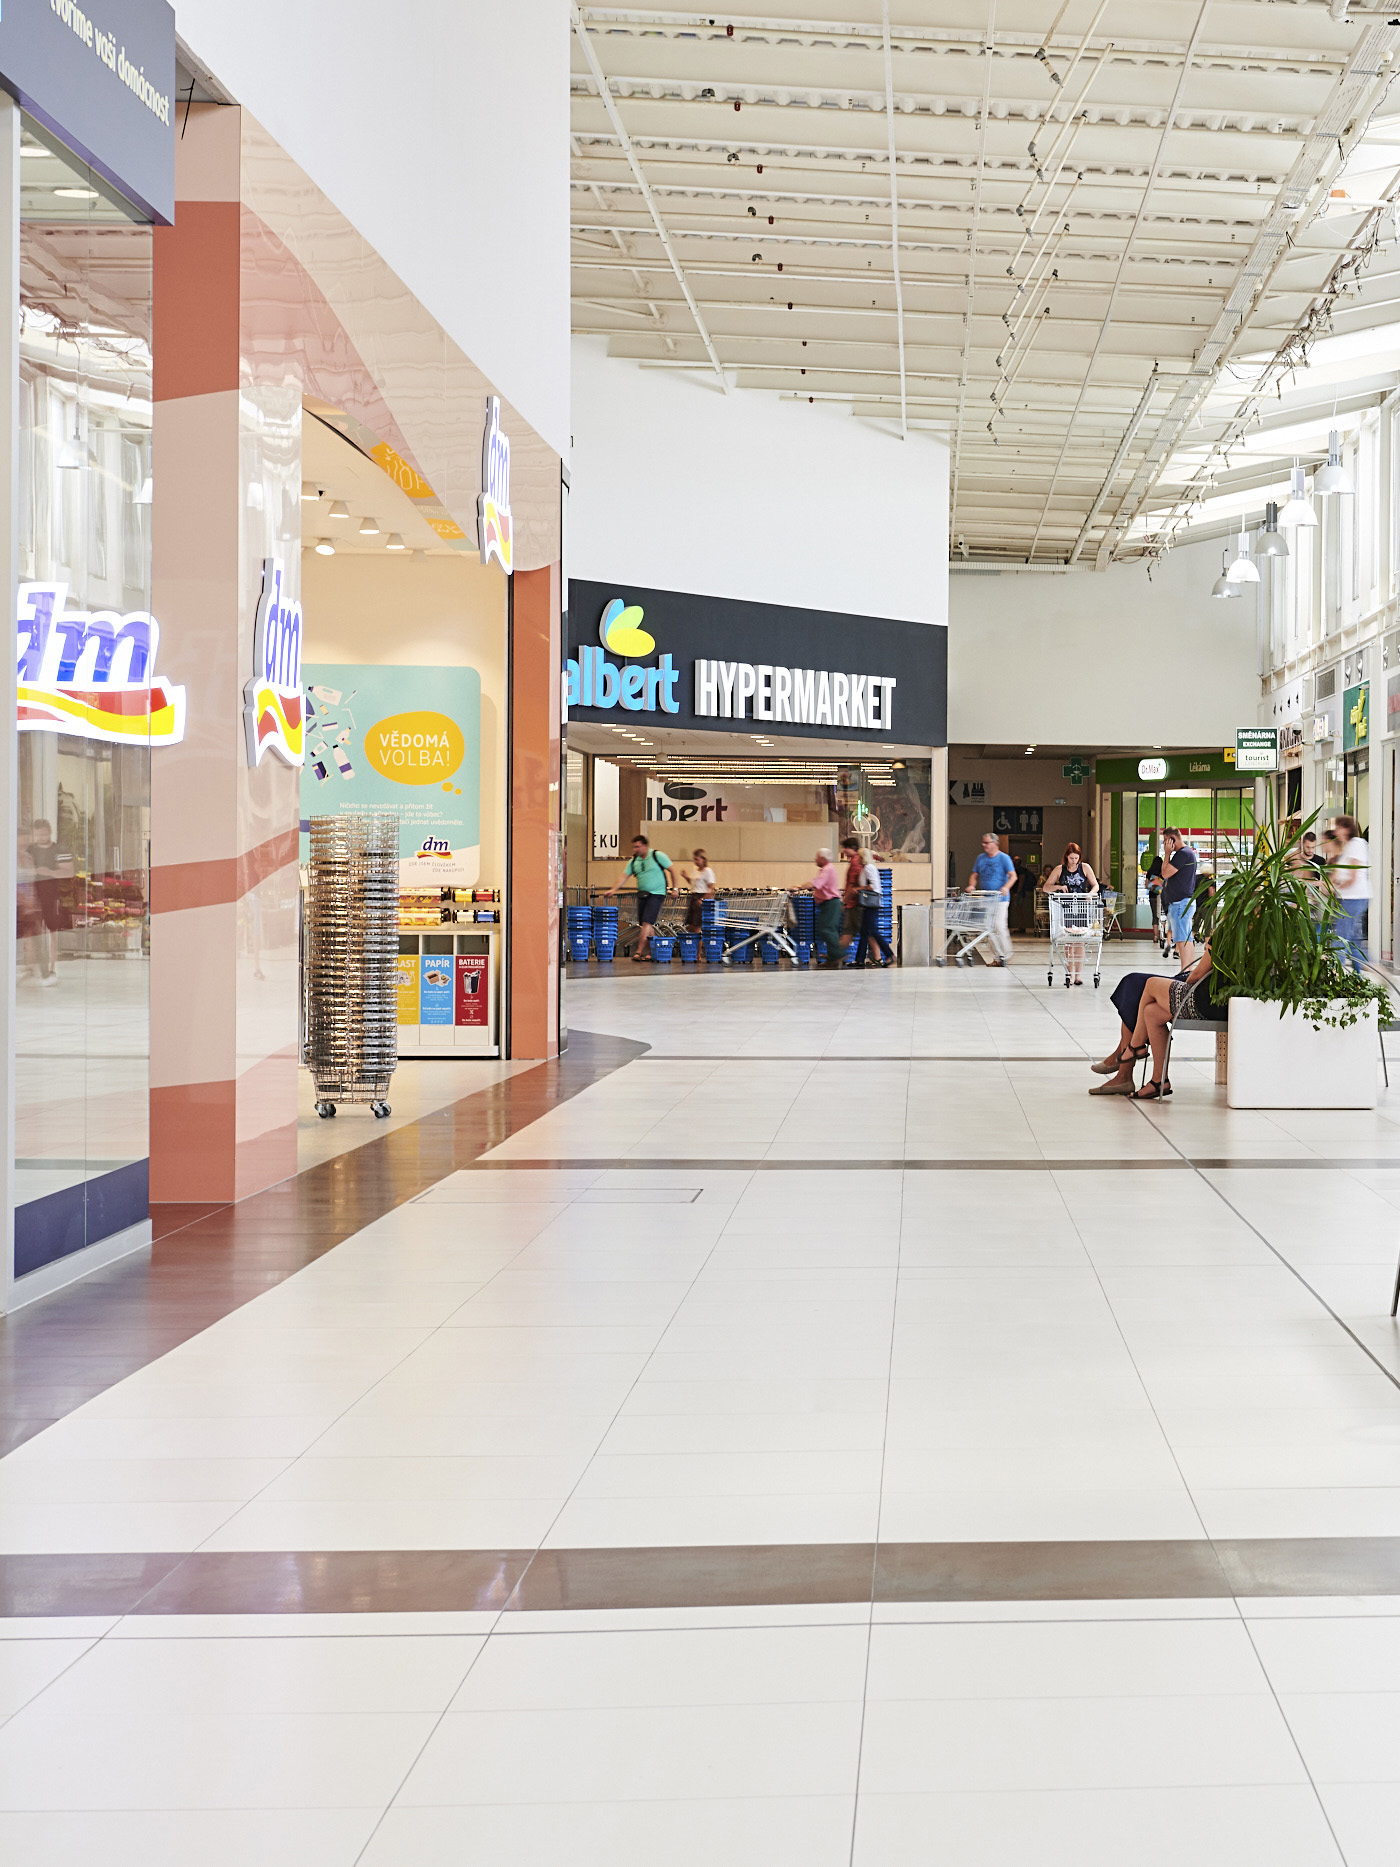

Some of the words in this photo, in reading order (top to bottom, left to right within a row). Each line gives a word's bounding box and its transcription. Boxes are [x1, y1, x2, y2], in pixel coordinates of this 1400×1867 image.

[94, 28, 117, 73] vaši
[117, 46, 170, 127] domácnost
[265, 569, 300, 690] dm
[567, 644, 680, 715] albert
[694, 658, 897, 730] HYPERMARKET
[379, 730, 450, 748] VĚDOMÁ
[1237, 731, 1276, 740] SMĚNÁRNA
[379, 749, 450, 767] VOLBA!
[1245, 754, 1270, 762] tourist
[1189, 762, 1211, 773] Lékárna
[422, 836, 449, 851] dm
[398, 959, 416, 968] AST
[425, 957, 450, 968] PAPÍR
[458, 958, 486, 966] BATERIE
